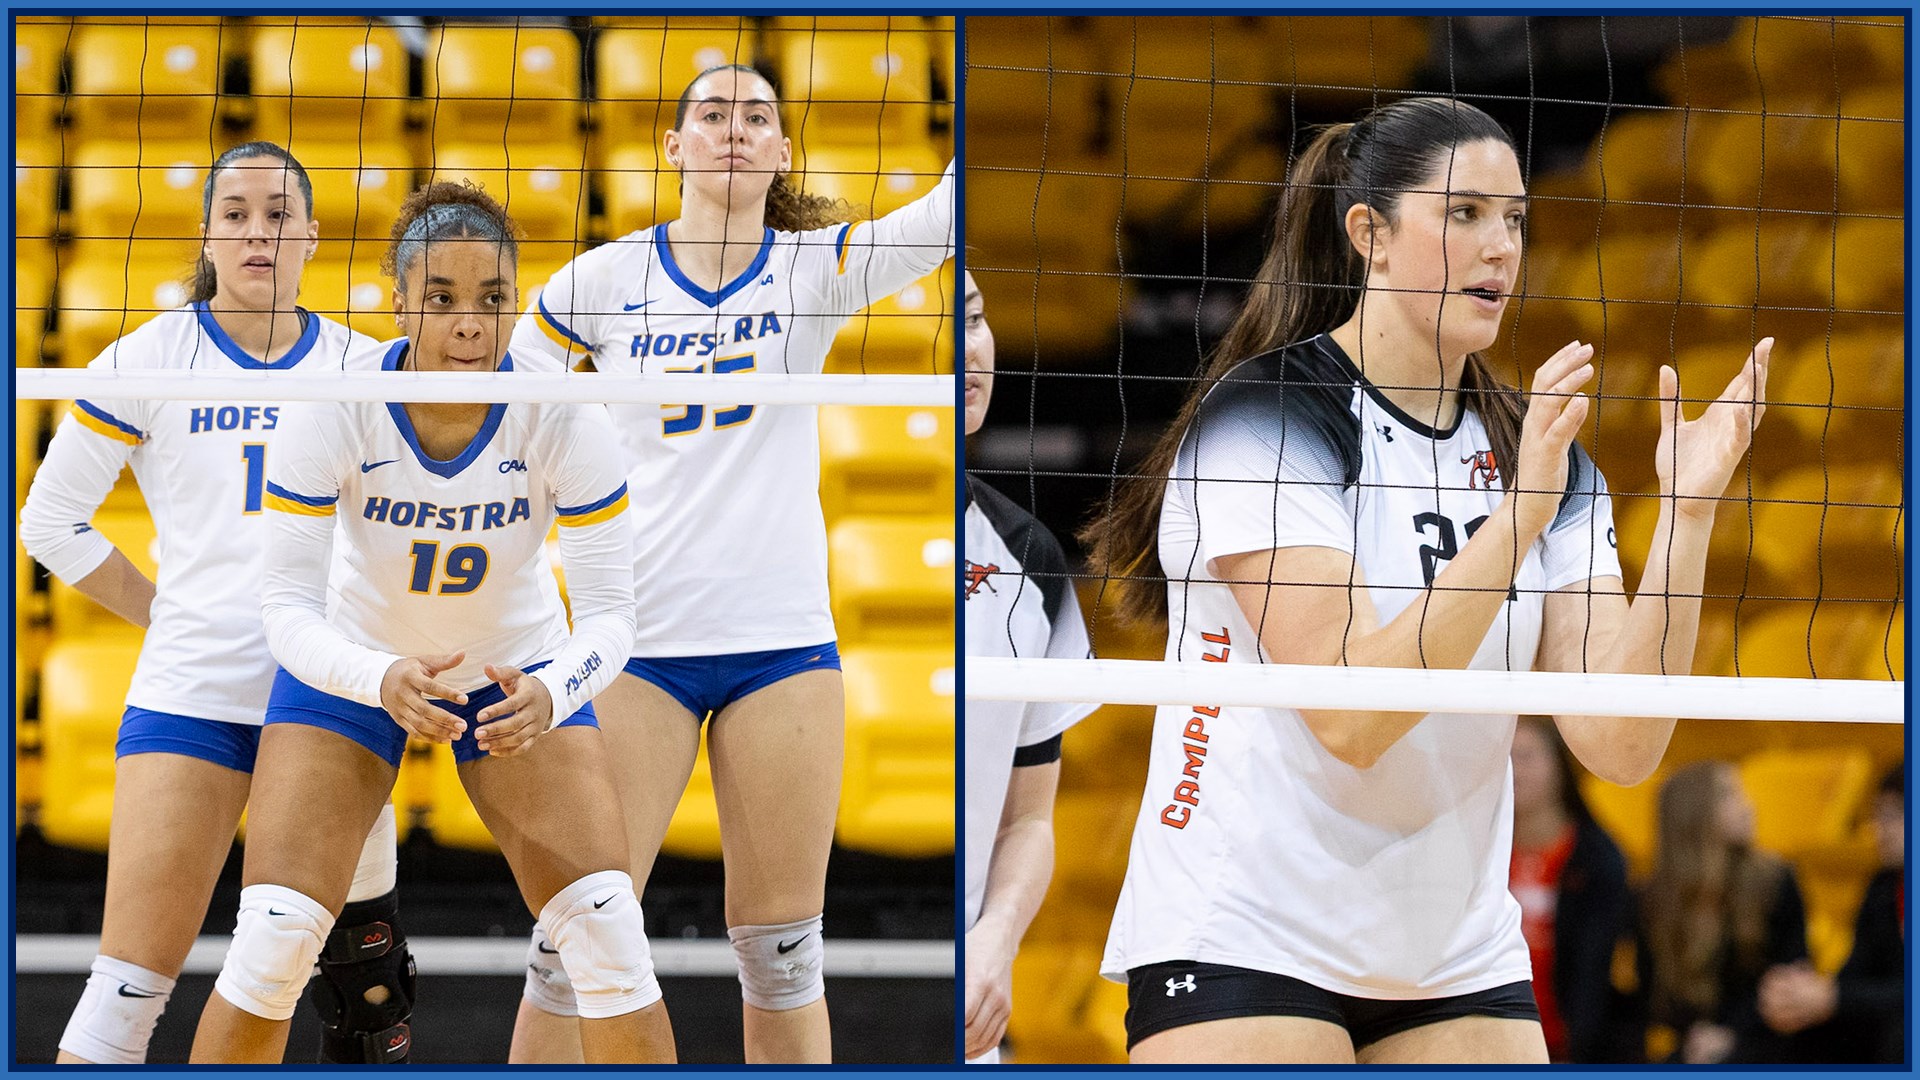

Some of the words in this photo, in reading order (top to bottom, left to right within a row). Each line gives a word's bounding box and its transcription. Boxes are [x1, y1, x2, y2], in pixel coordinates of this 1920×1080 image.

[499, 459, 528, 473] CAA
[363, 496, 530, 532] HOFSTRA
[408, 539, 490, 596] 19
[1161, 626, 1231, 829] CAMPLL
